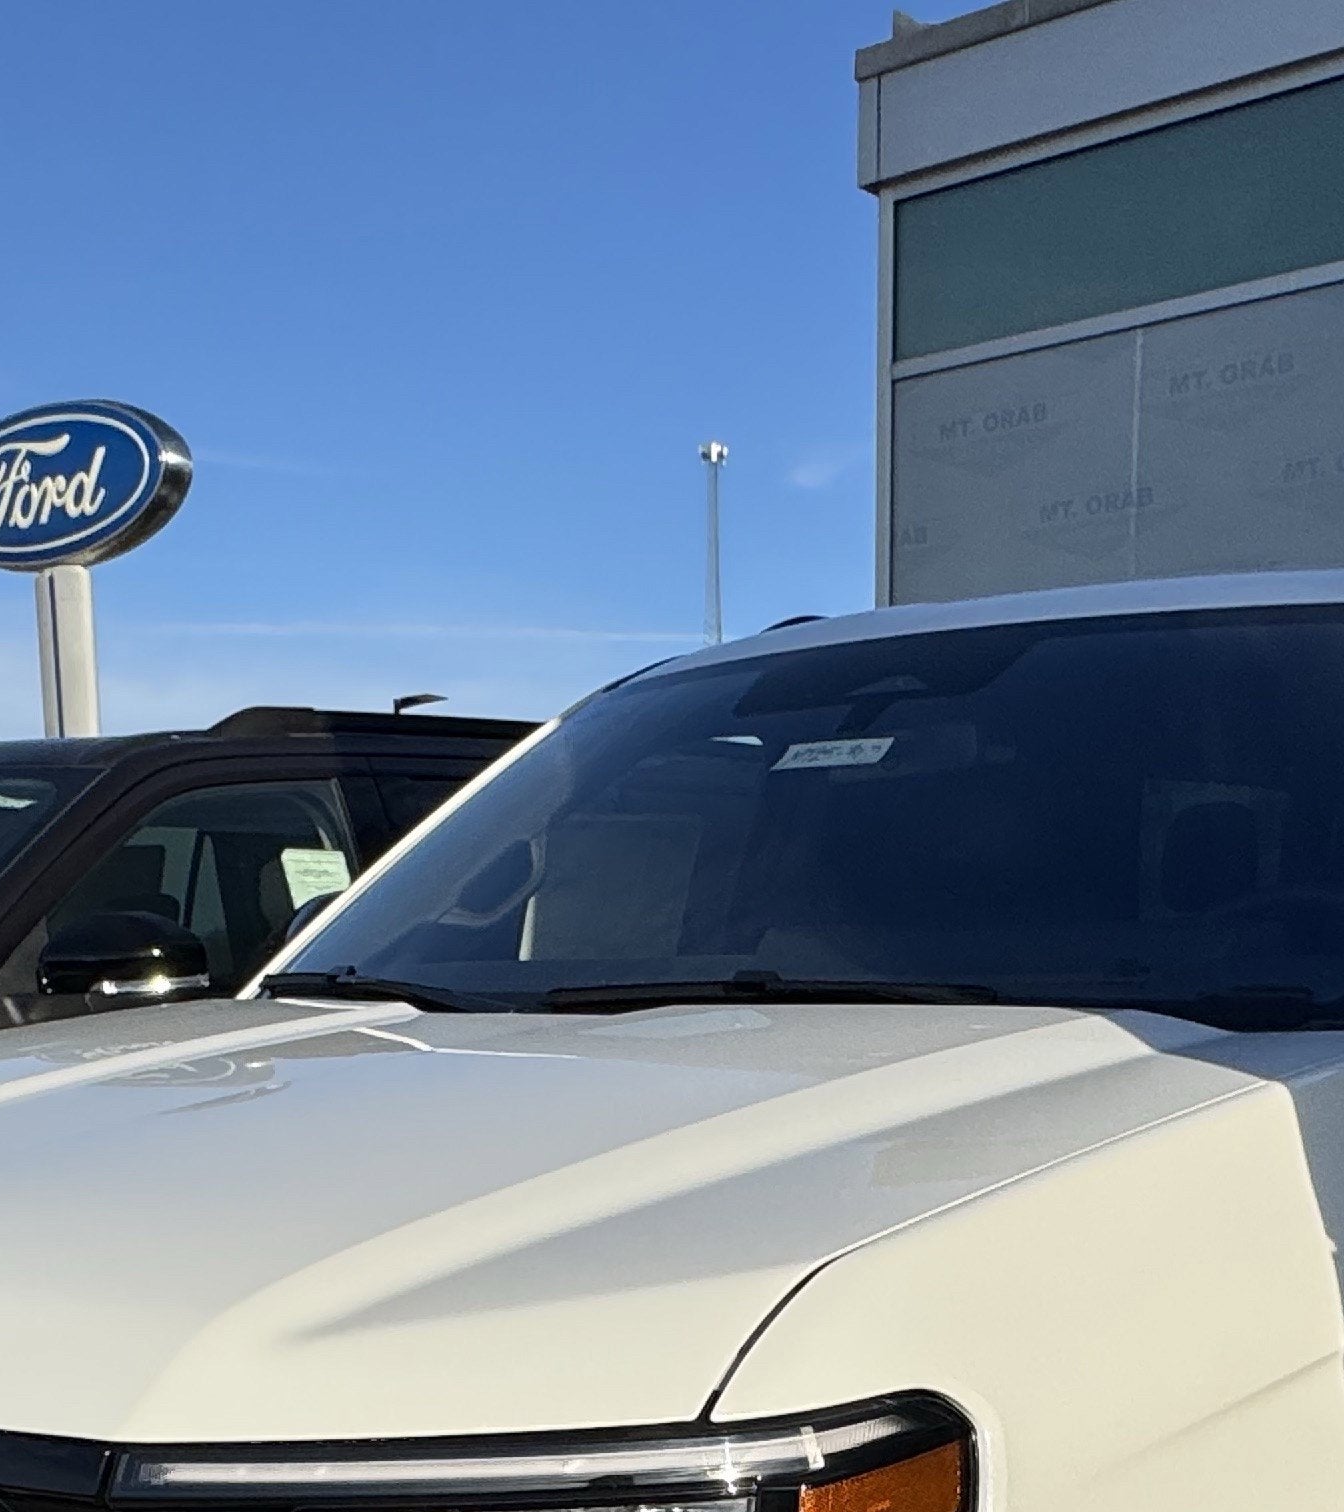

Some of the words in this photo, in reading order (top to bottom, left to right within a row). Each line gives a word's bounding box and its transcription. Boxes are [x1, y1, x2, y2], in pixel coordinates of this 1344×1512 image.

[1169, 368, 1212, 397] MT.
[1220, 351, 1295, 386] ORAB
[982, 401, 1048, 434] ORAB
[1084, 485, 1155, 518] ORAB
